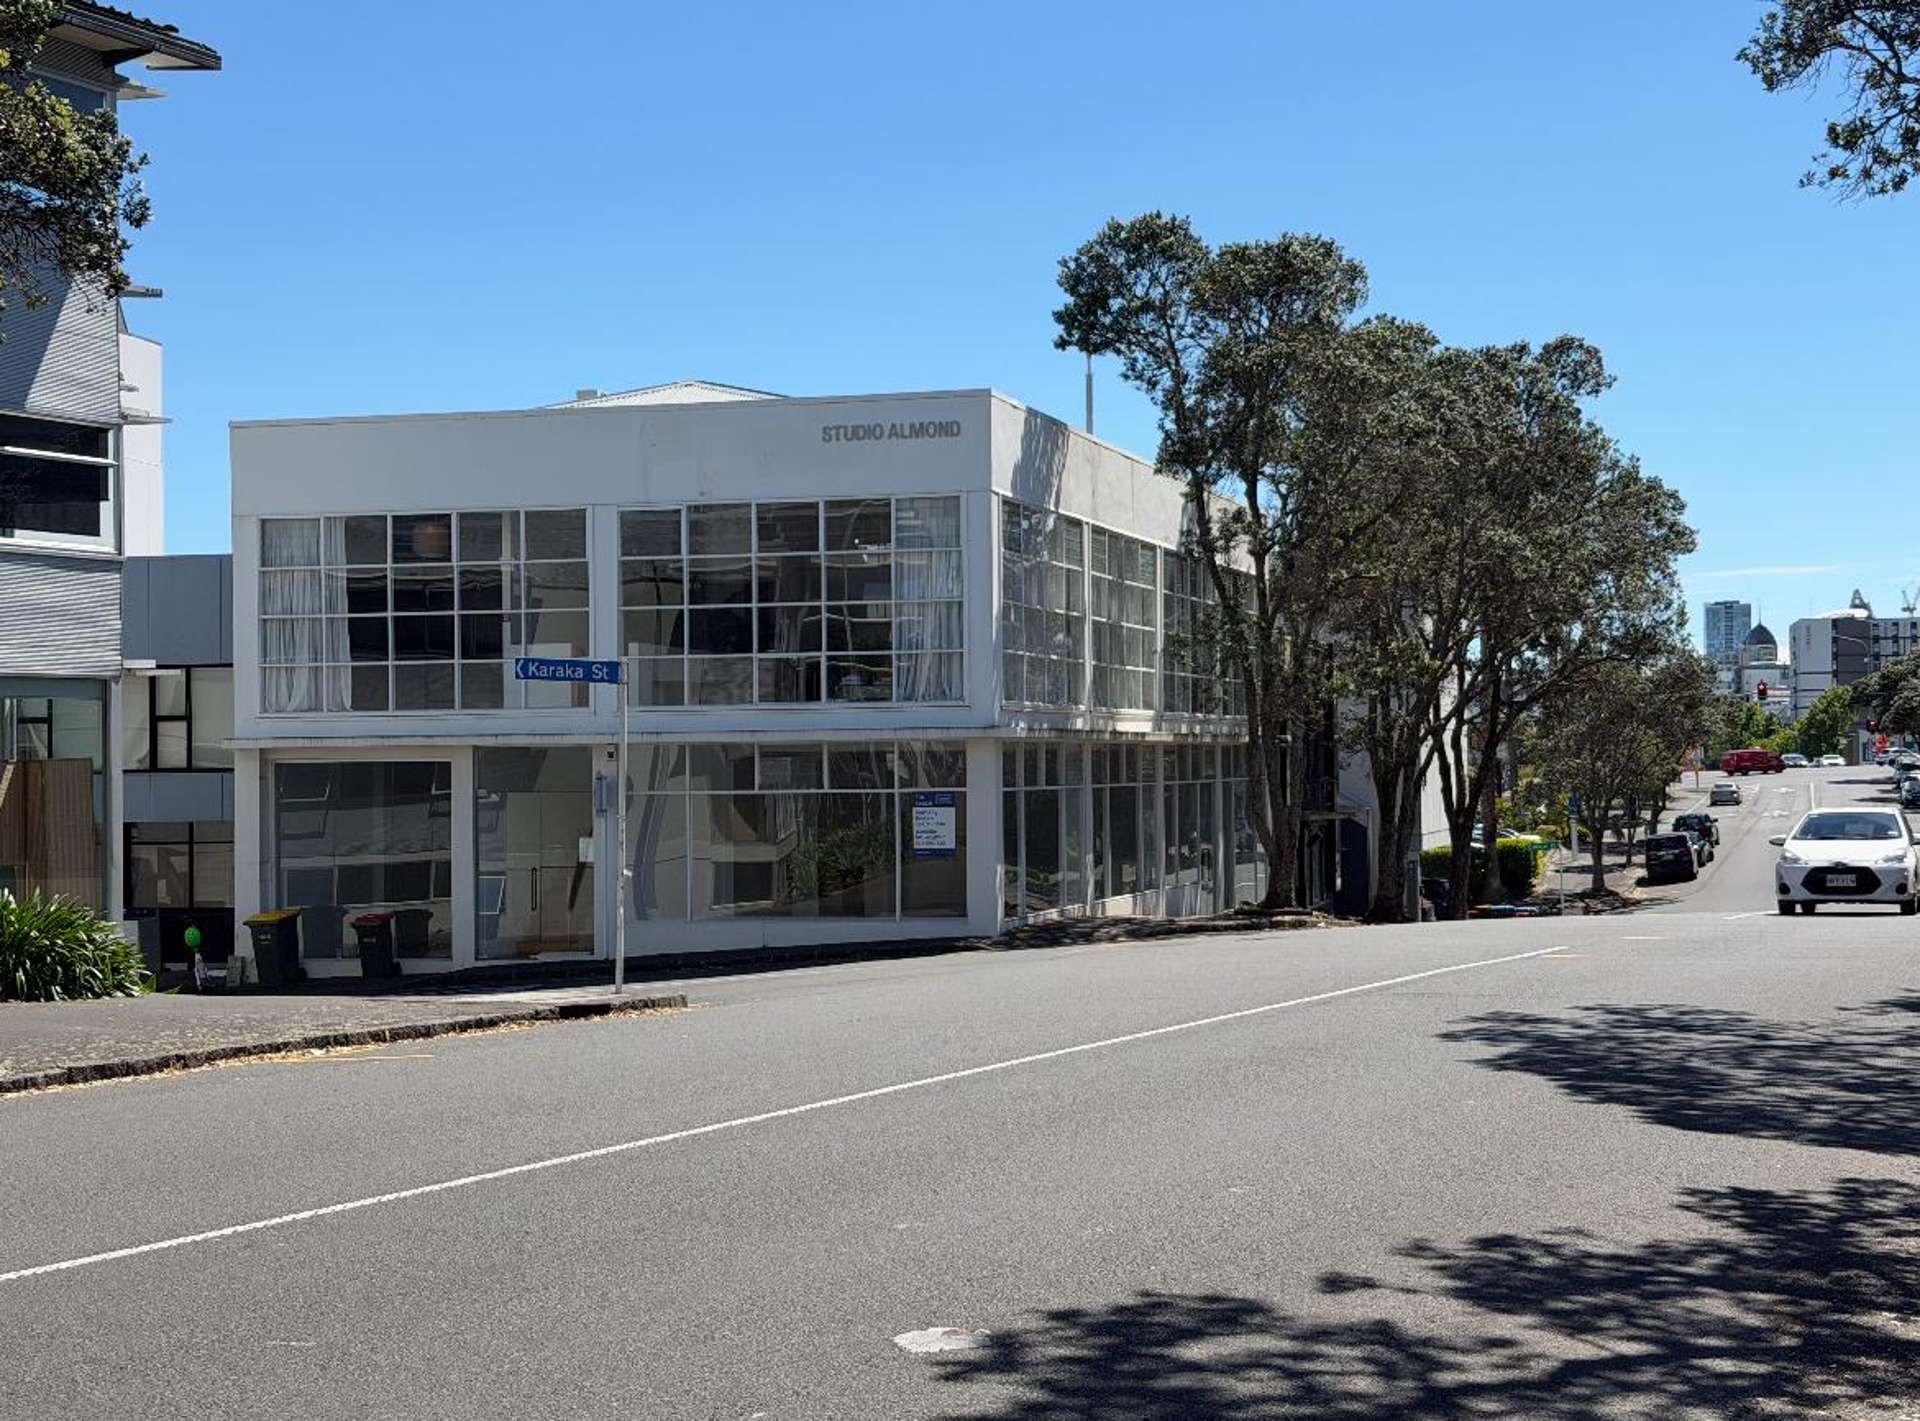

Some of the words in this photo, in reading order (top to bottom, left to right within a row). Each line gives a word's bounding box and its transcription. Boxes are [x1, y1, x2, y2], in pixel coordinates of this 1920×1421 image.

[822, 423, 884, 442] STUDIO
[888, 420, 961, 439] ALMOND
[528, 661, 584, 679] Karaka
[592, 664, 608, 680] St
